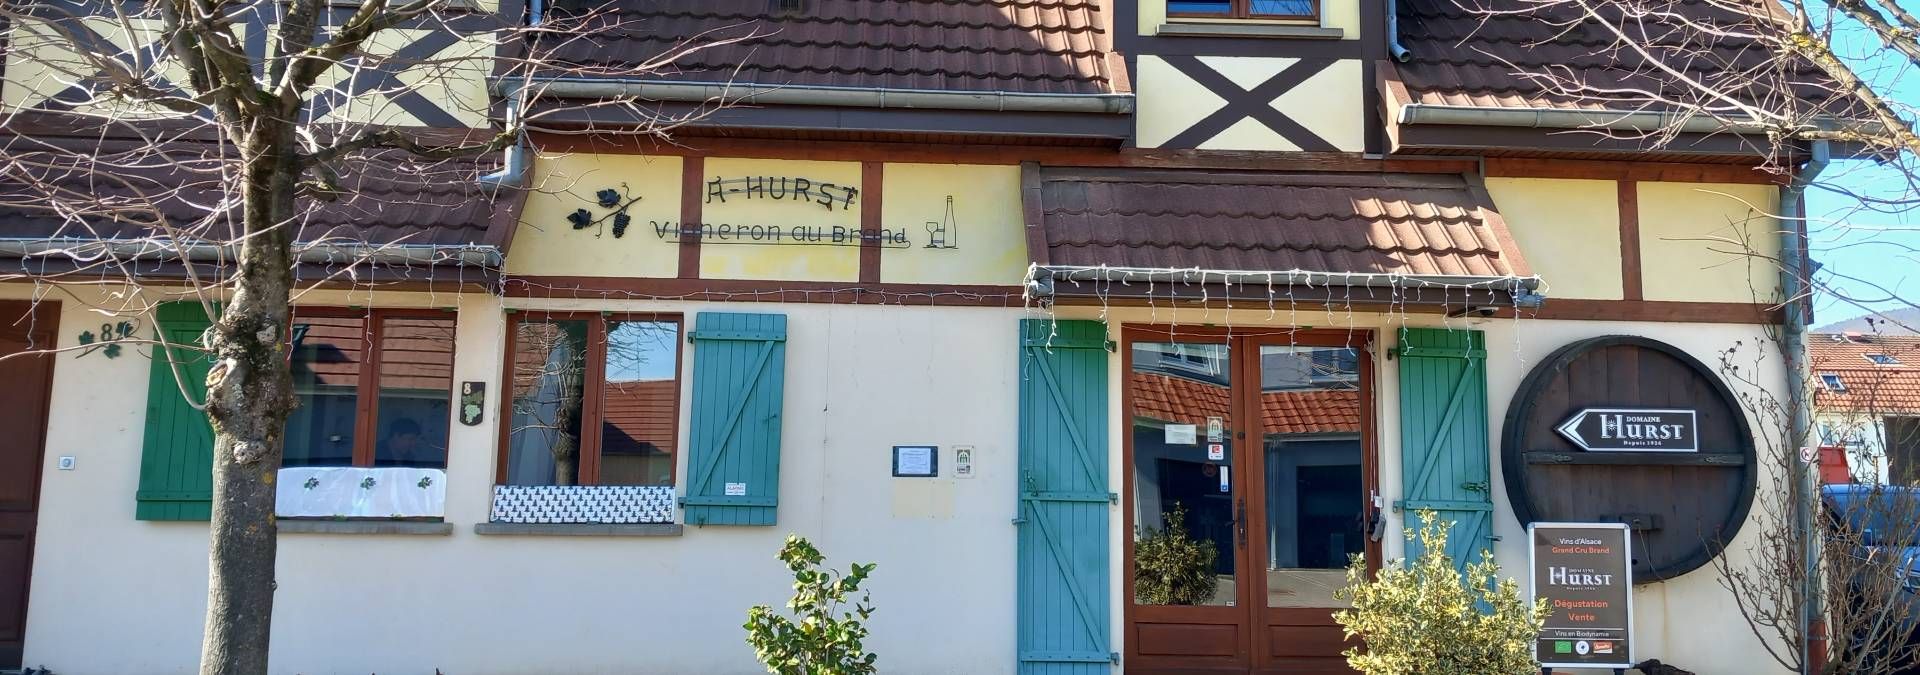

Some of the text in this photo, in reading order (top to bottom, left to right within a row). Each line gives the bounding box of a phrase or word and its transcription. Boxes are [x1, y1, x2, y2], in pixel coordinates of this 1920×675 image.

[650, 220, 909, 244] Vigneron au Brand
[101, 323, 112, 341] 8
[463, 383, 471, 395] 8
[1574, 537, 1602, 545] d'Alsace
[1552, 546, 1610, 554] Grand Cru Brand
[1568, 613, 1595, 622] Vente
[1576, 630, 1610, 638] Biodynamie
